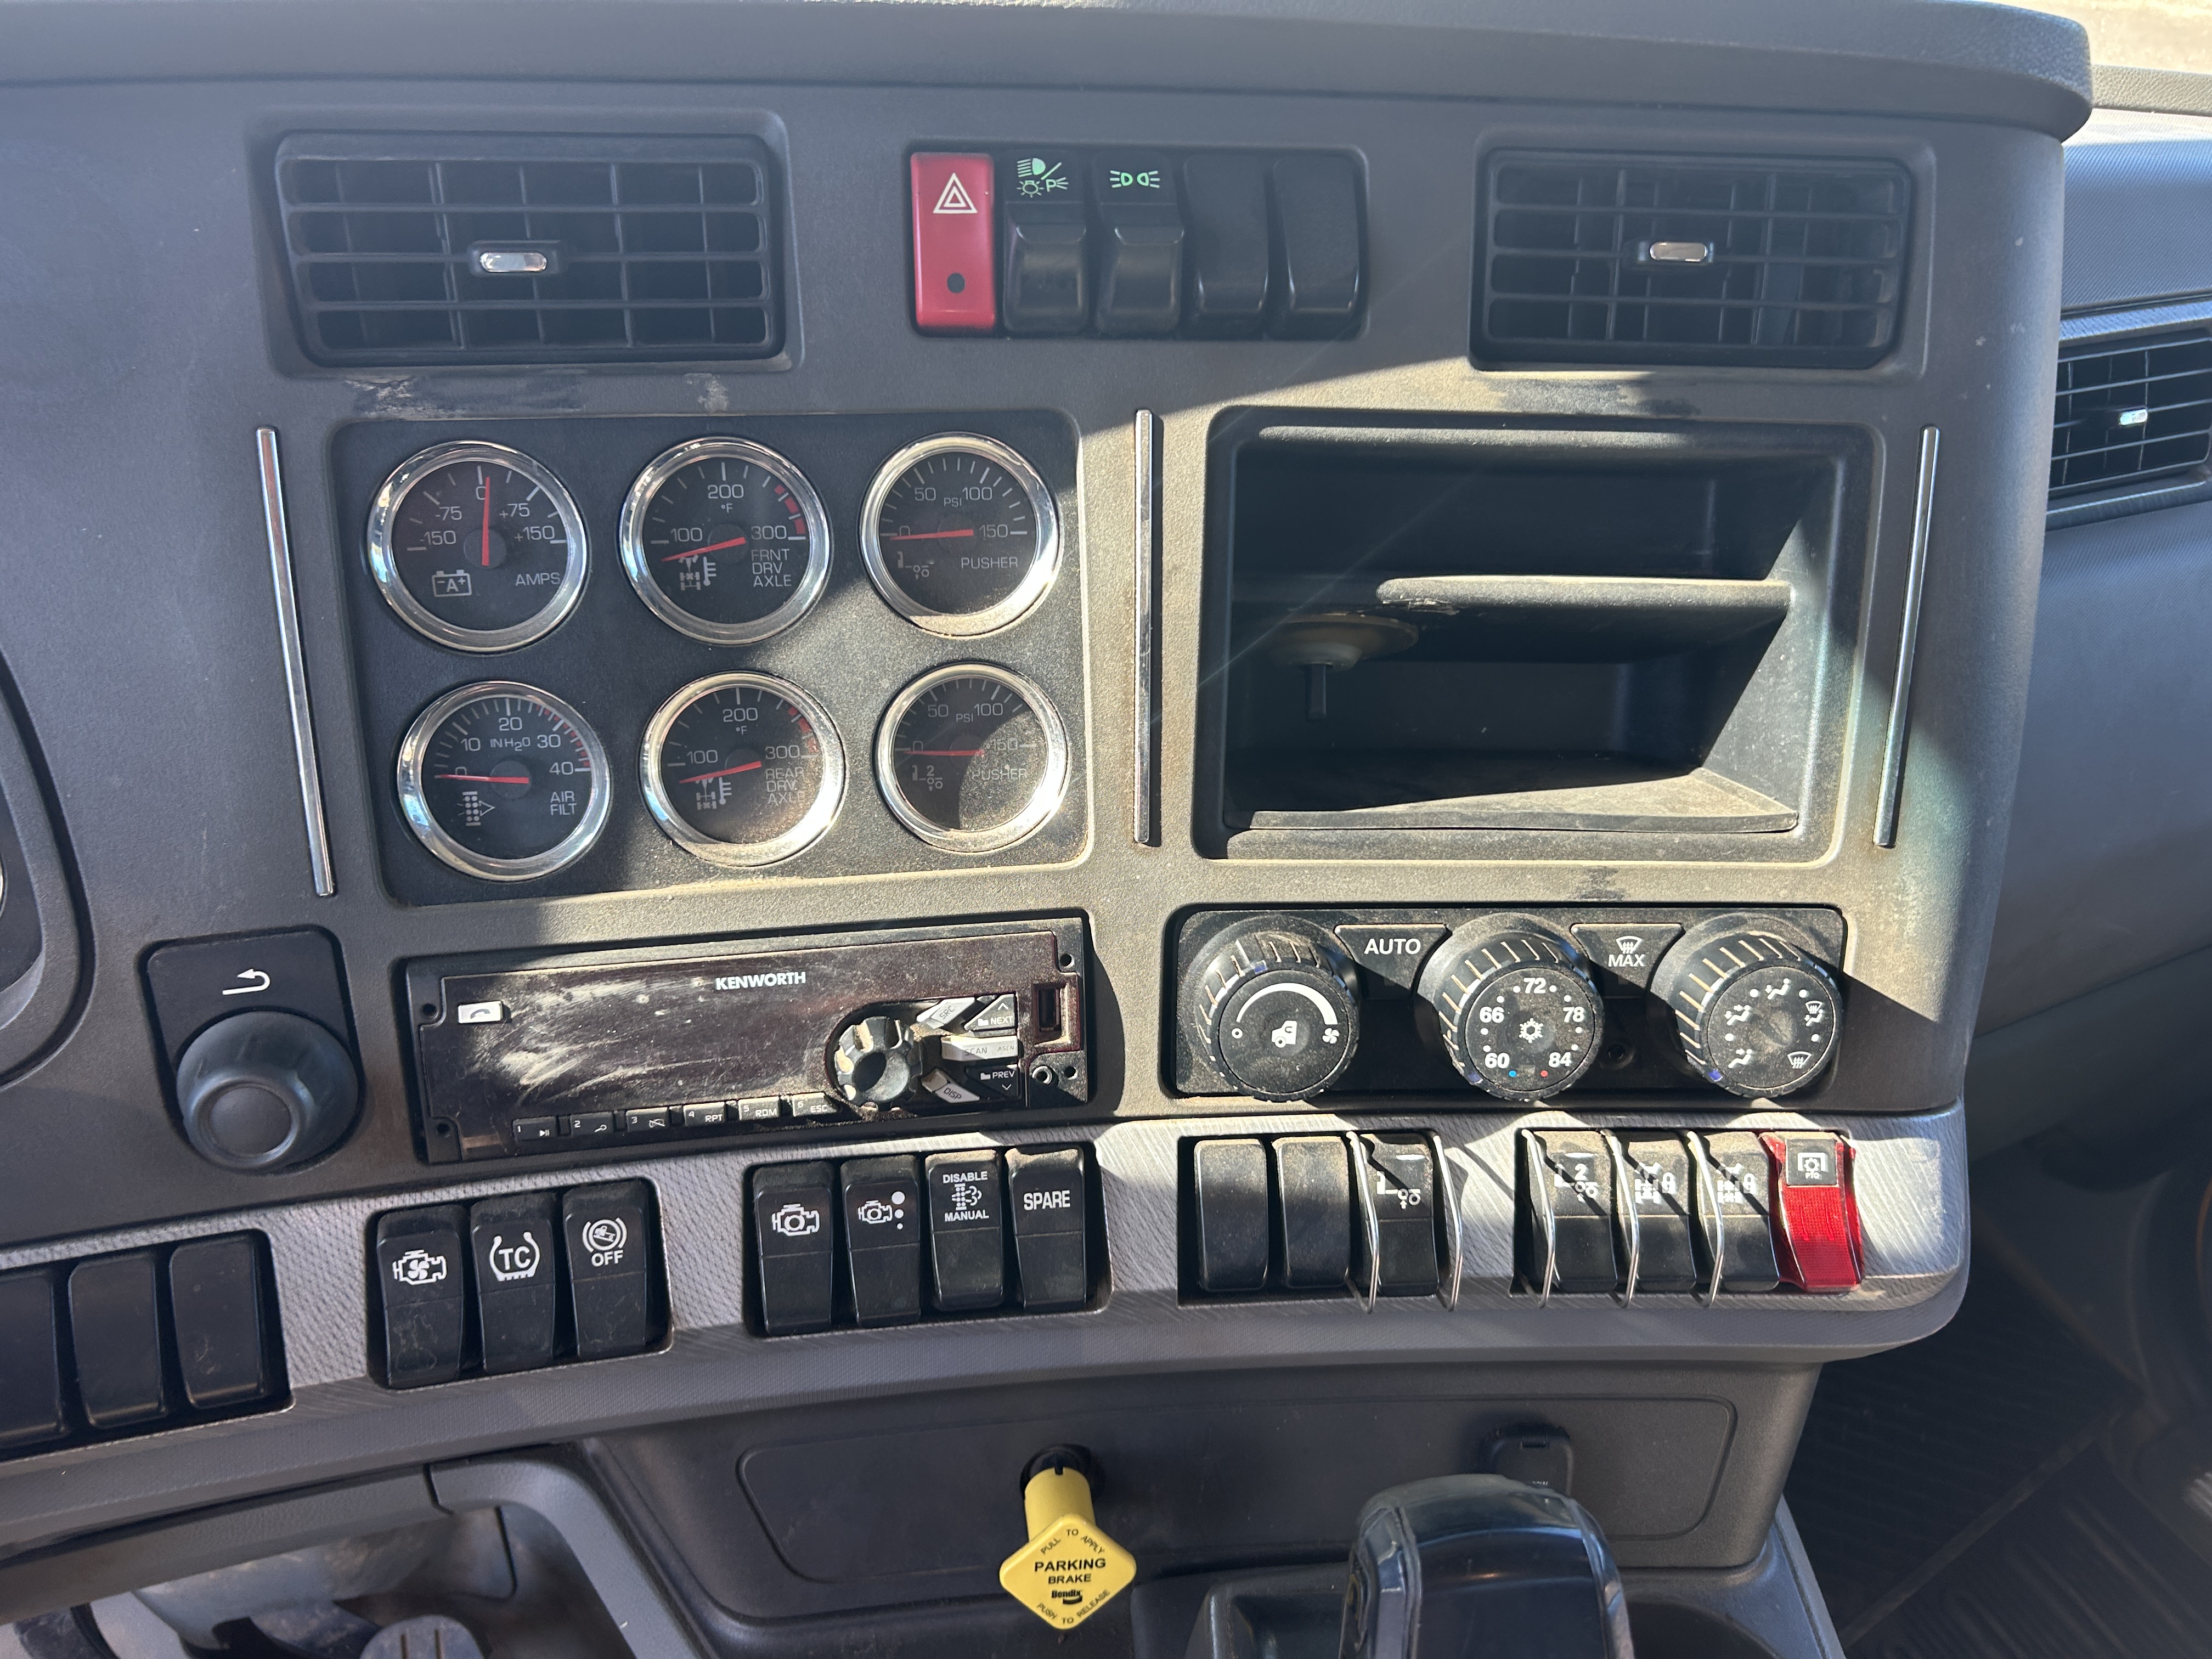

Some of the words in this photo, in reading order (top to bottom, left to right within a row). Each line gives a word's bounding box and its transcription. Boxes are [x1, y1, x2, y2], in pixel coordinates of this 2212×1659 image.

[708, 484, 744, 499] 200
[915, 488, 936, 501] 50
[962, 487, 992, 500] 100
[944, 498, 962, 507] PSI
[670, 527, 703, 542] 100
[751, 526, 787, 540] 300
[979, 524, 1008, 537] 150
[752, 549, 789, 561] FRNT
[752, 562, 782, 574] DRV
[961, 557, 1018, 569] PUSHER
[515, 572, 561, 586] AMPS
[753, 574, 792, 587] AXLE
[723, 708, 758, 722] 200
[928, 704, 949, 718] 50
[974, 703, 1003, 716] 100
[499, 717, 522, 731] 20
[956, 714, 973, 723] PSI
[461, 738, 481, 751] 10
[537, 734, 560, 748] 30
[687, 750, 718, 764] 100
[765, 745, 800, 759] 300
[549, 761, 573, 775] 40
[765, 768, 804, 780] REAR
[768, 780, 797, 792] DRV
[550, 791, 574, 803] AIR
[768, 791, 806, 804] AXLE
[551, 803, 577, 815] FILT
[1364, 938, 1421, 955] AUTO
[1608, 953, 1645, 967] MAX
[716, 972, 806, 990] KENWORTH
[1523, 978, 1547, 994] 72
[940, 1006, 955, 1019] SRC
[1479, 1007, 1504, 1024] 66
[1563, 1007, 1584, 1023] 78
[990, 1016, 1013, 1025] NEXT
[965, 1047, 988, 1056] SCAN
[1484, 1053, 1510, 1069] 60
[1548, 1053, 1571, 1068] 84
[944, 1088, 962, 1099] DISP
[755, 1108, 777, 1118] RDM
[810, 1104, 827, 1113] ESC
[705, 1114, 723, 1122] RPT
[943, 1171, 988, 1183] DISABLE
[1023, 1190, 1070, 1210] SPARE
[944, 1210, 989, 1222] MANUAL
[499, 1246, 531, 1269] TC
[591, 1250, 623, 1267] OFF
[1041, 1538, 1061, 1555] PULL
[1081, 1536, 1105, 1554] APPLY
[1035, 1558, 1106, 1572] PARKING
[1048, 1573, 1091, 1584] BRAKE
[1051, 1589, 1081, 1598] Bendix
[1037, 1602, 1057, 1619] PUSH
[1076, 1589, 1110, 1618] RELEASE
